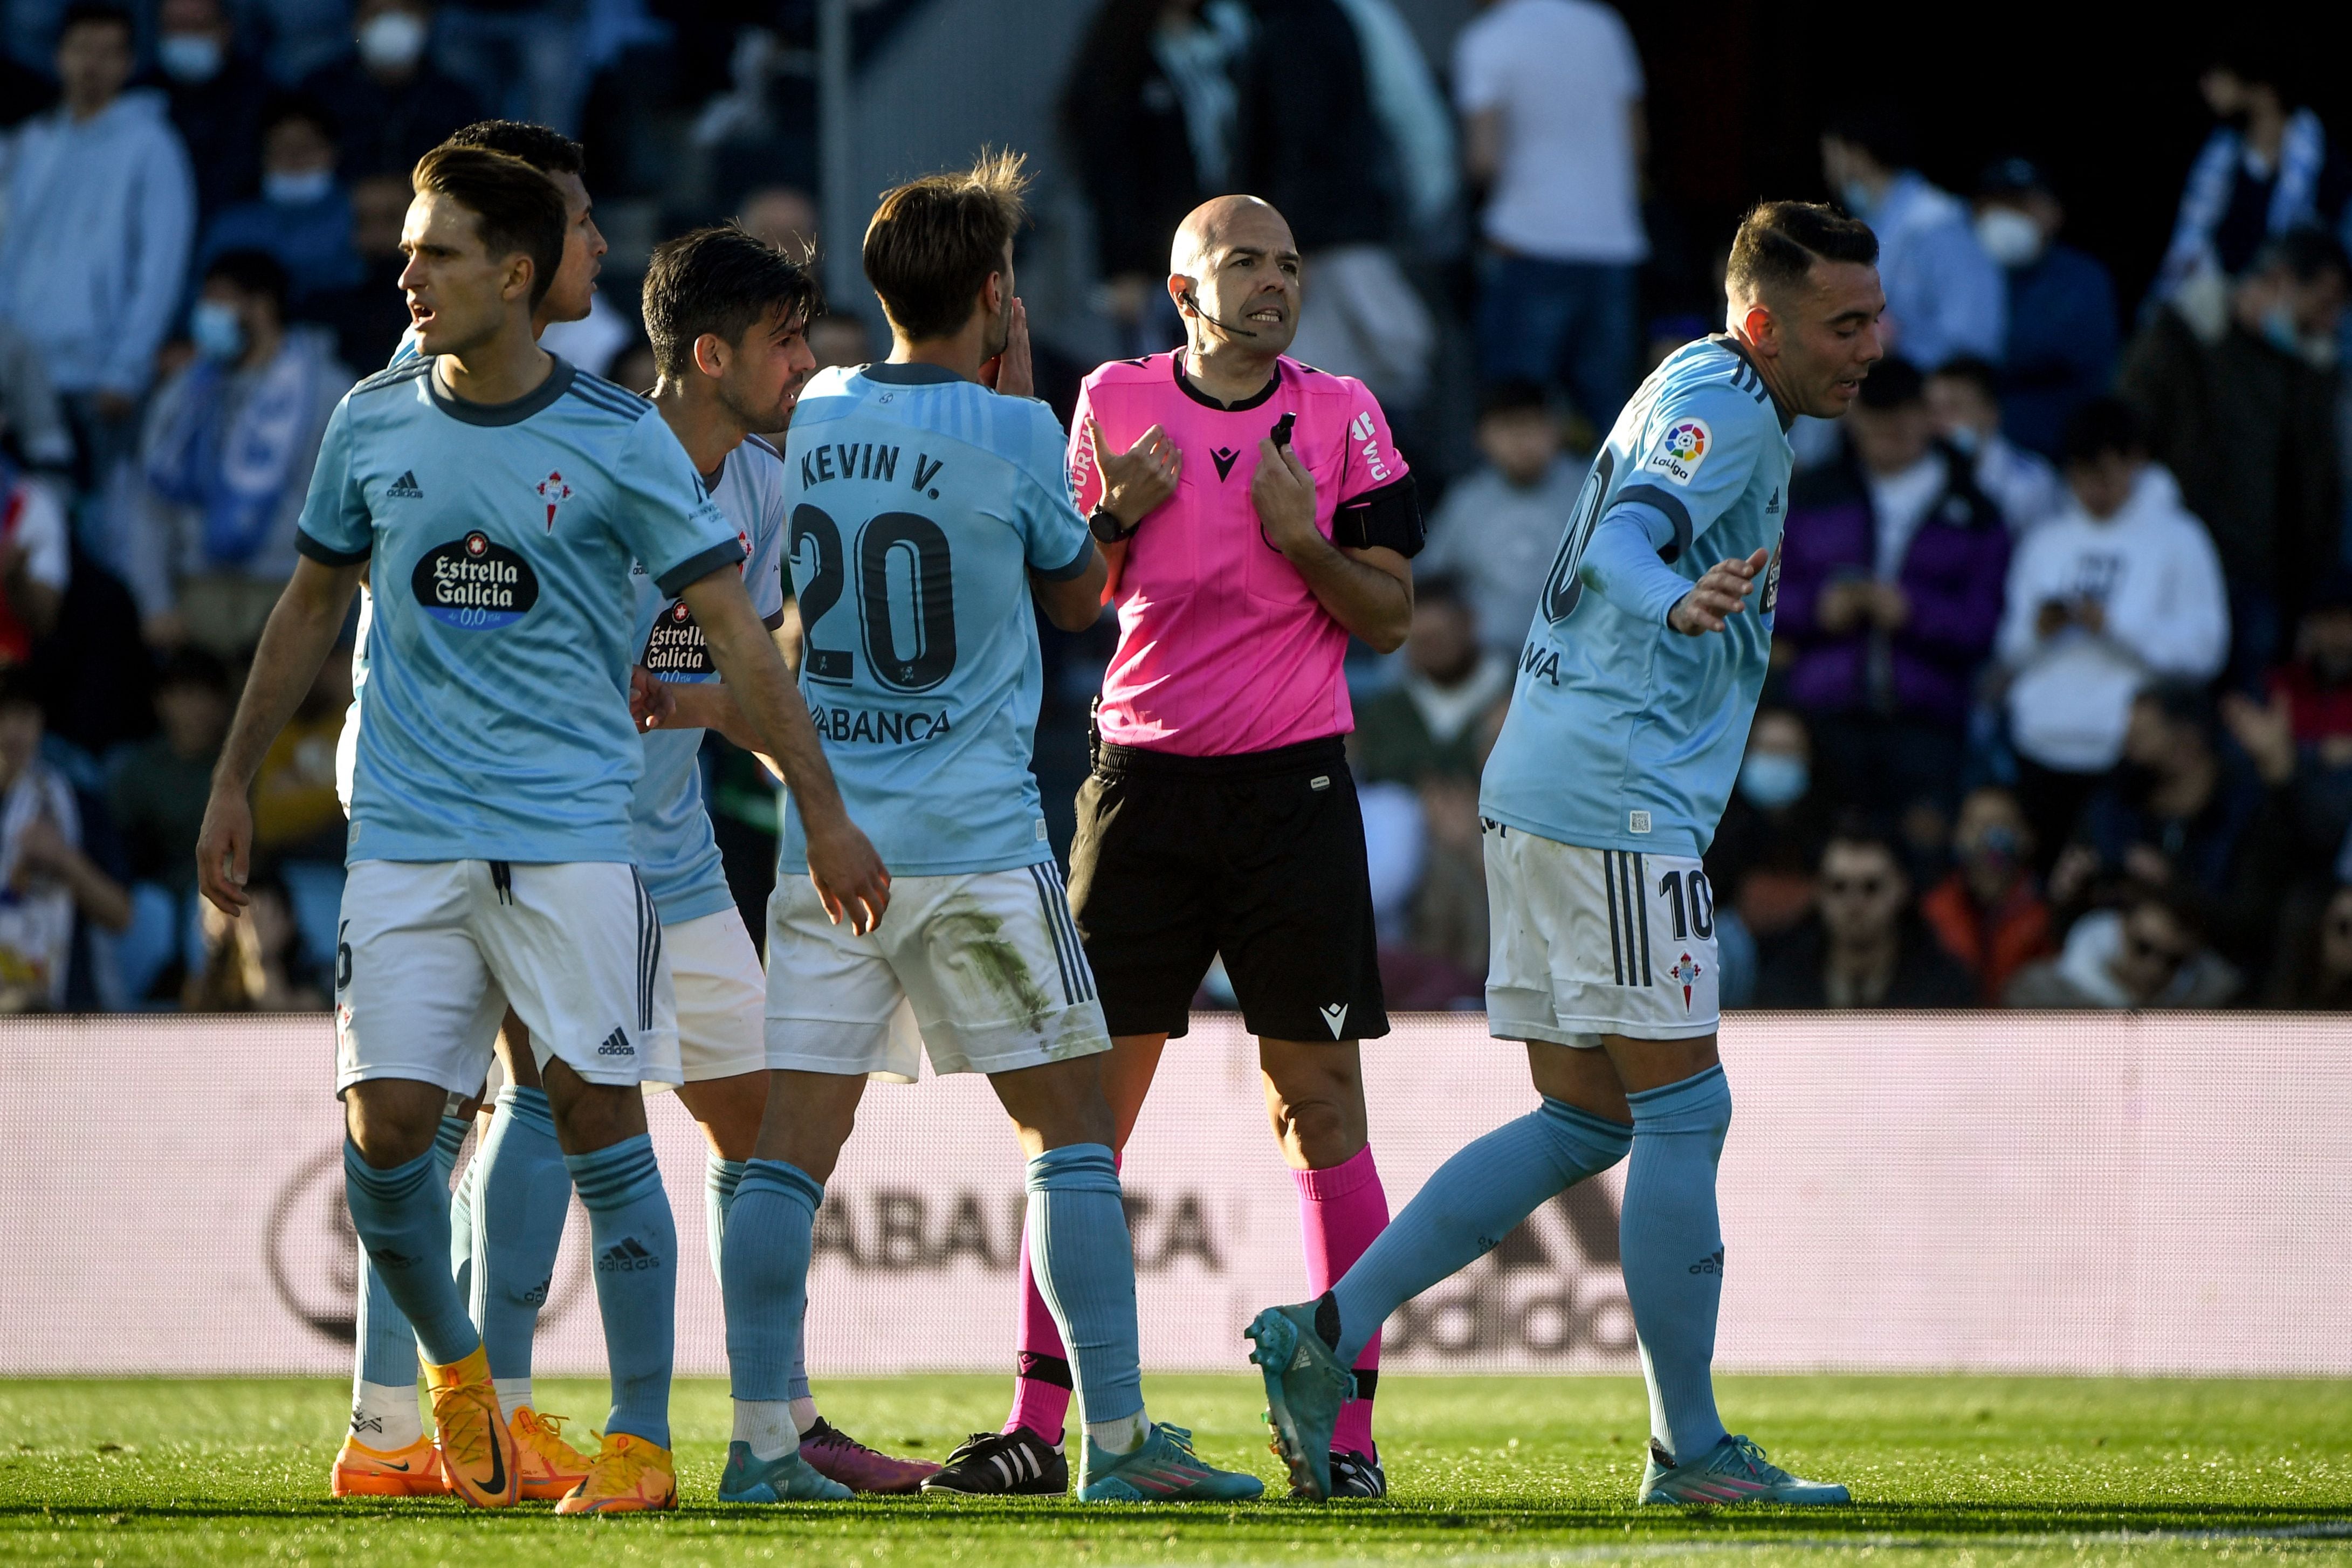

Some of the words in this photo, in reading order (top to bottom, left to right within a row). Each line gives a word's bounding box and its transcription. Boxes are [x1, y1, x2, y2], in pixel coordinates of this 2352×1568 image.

[801, 443, 900, 491] KEVIN
[912, 452, 944, 499] V.
[1652, 456, 1688, 480] LaLiga
[386, 487, 424, 499] adidas
[433, 555, 518, 584] Estrella
[436, 579, 513, 607] Galicia
[789, 503, 958, 693] 20
[647, 647, 704, 669] Galicia
[811, 704, 951, 744] ABANCA
[1659, 870, 1713, 941] 10
[597, 1046, 635, 1055] adidas
[598, 1257, 659, 1271] adidas
